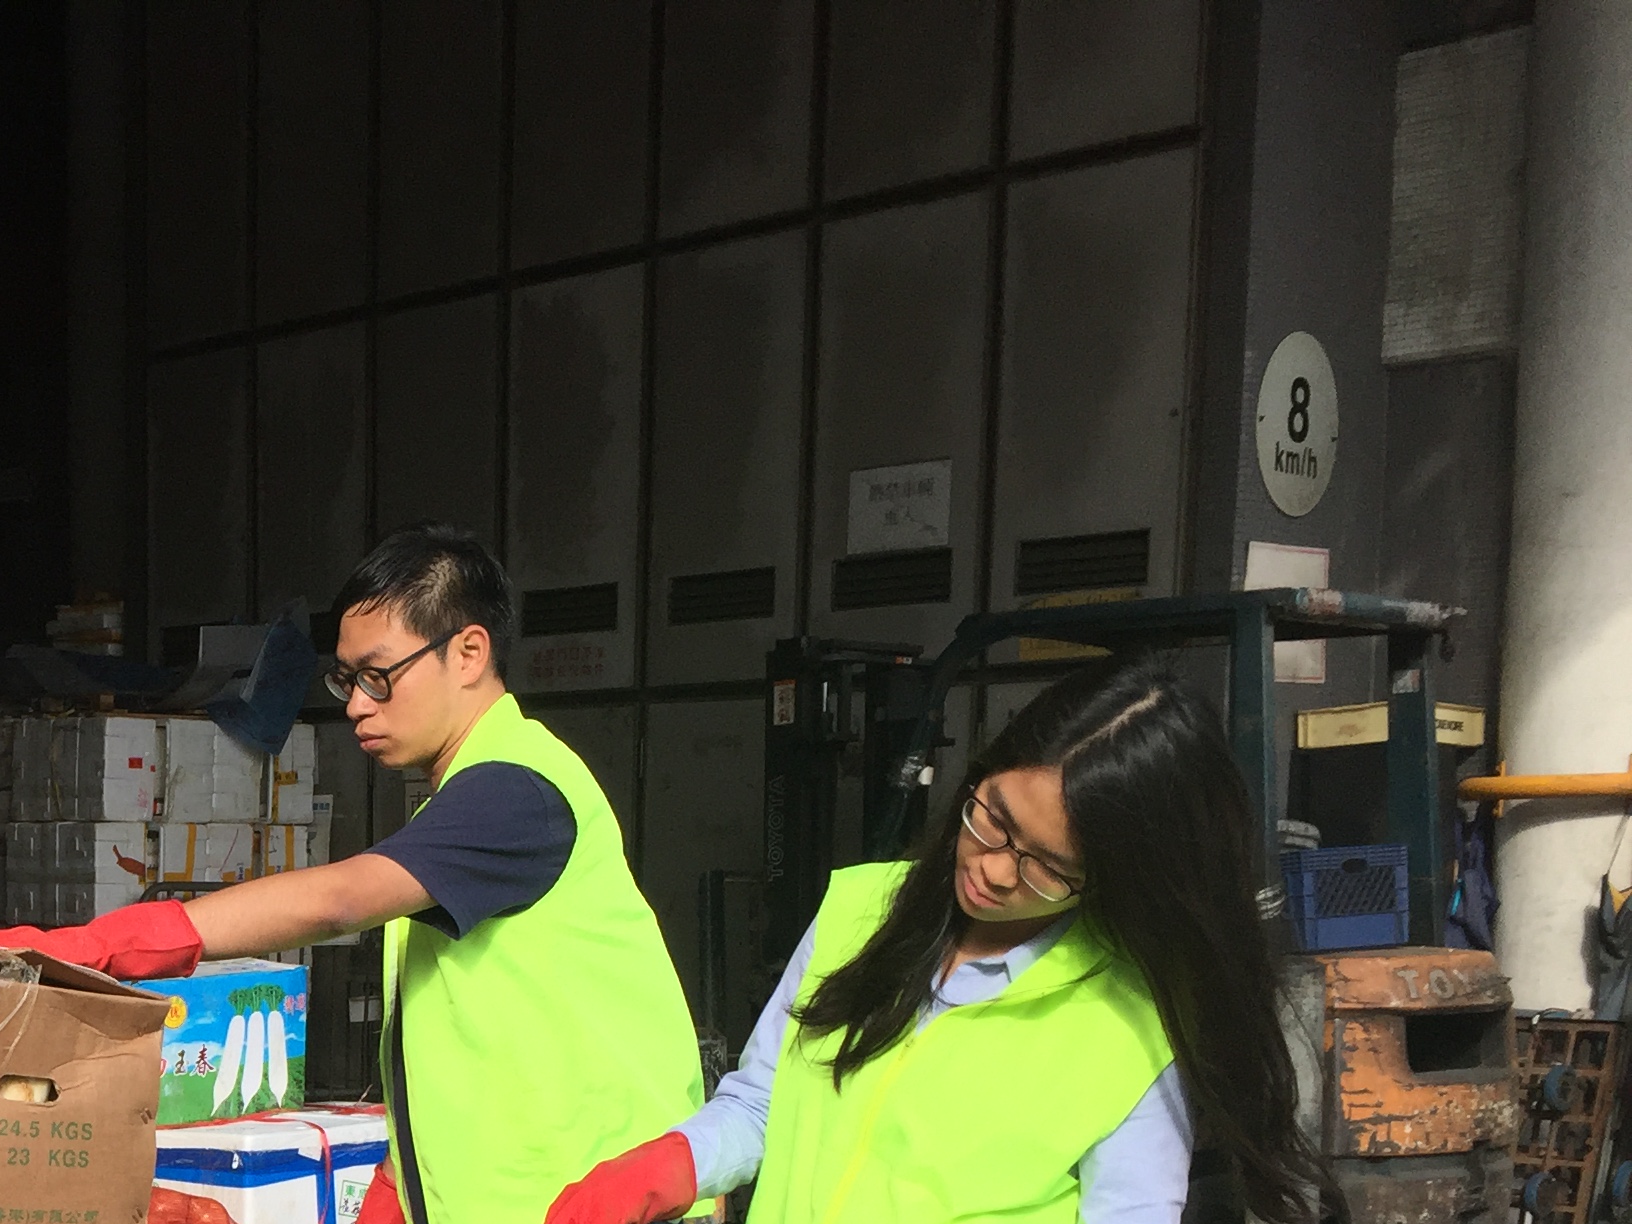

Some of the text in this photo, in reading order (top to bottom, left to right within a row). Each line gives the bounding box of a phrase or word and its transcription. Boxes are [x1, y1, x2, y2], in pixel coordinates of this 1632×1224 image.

[1287, 377, 1311, 443] 8
[1274, 442, 1319, 480] km/h
[50, 1121, 93, 1140] KGS
[7, 1148, 31, 1166] 23
[48, 1149, 90, 1168] KGS
